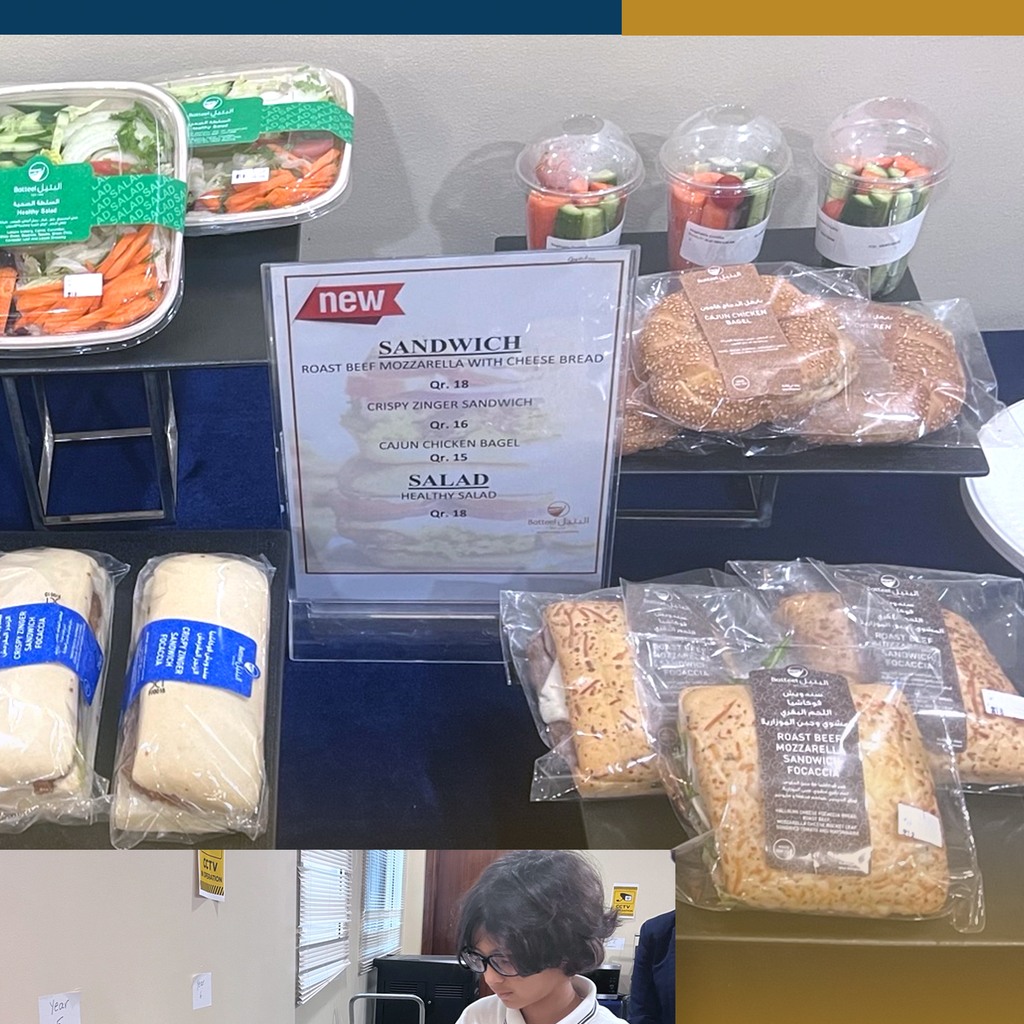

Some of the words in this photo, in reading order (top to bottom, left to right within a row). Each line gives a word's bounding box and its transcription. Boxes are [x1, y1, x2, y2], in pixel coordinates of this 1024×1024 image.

[110, 182, 144, 211] SALAD
[143, 185, 175, 210] SALAD
[110, 196, 144, 224] SALAD
[319, 289, 385, 313] new
[704, 312, 731, 321] CAJUN
[732, 309, 768, 319] CHICKEN
[725, 318, 753, 326] BAGEL
[378, 335, 522, 355] SANDWICH
[301, 363, 342, 374] ROAST
[346, 361, 376, 373] BEEF
[379, 359, 465, 371] MOZZARELLA
[467, 357, 503, 368] WITH
[506, 355, 556, 367] CHEESE
[559, 353, 604, 365] BREAD
[430, 380, 450, 390] Qr.
[454, 379, 469, 389] 18
[367, 401, 409, 412] CRISPY
[412, 400, 459, 410] ZINGER
[461, 397, 533, 409] SANDWICH
[430, 420, 450, 430] Qr.
[453, 419, 468, 429] 16
[379, 440, 419, 451] CAJUN
[422, 439, 476, 450] CHICKEN
[479, 437, 520, 449] BAGEL
[430, 453, 450, 463] Qr.
[453, 452, 468, 462] 15
[408, 473, 490, 487] SALAD
[401, 491, 455, 501] HEALTHY
[457, 490, 497, 500] SALAD
[430, 509, 450, 519] Qr.
[453, 509, 467, 519] 18
[17, 610, 27, 634] ZINGER
[24, 617, 36, 651] SANDWICH
[34, 617, 46, 649] FOCACCIA
[180, 626, 191, 649] CRISPY
[875, 632, 906, 643] ROAST
[13, 636, 24, 660] CRISPY
[155, 634, 168, 666] FOCACCIA
[165, 632, 179, 667] SANDWICH
[175, 650, 187, 675] ZINGER
[777, 732, 811, 742] ROAST
[814, 733, 842, 743] BEEF
[776, 743, 844, 755] MOZZARELL
[783, 754, 840, 766] SANDWIC
[787, 766, 840, 777] FOCACCIA
[203, 858, 218, 871] CCTV
[49, 999, 69, 1015] Year
